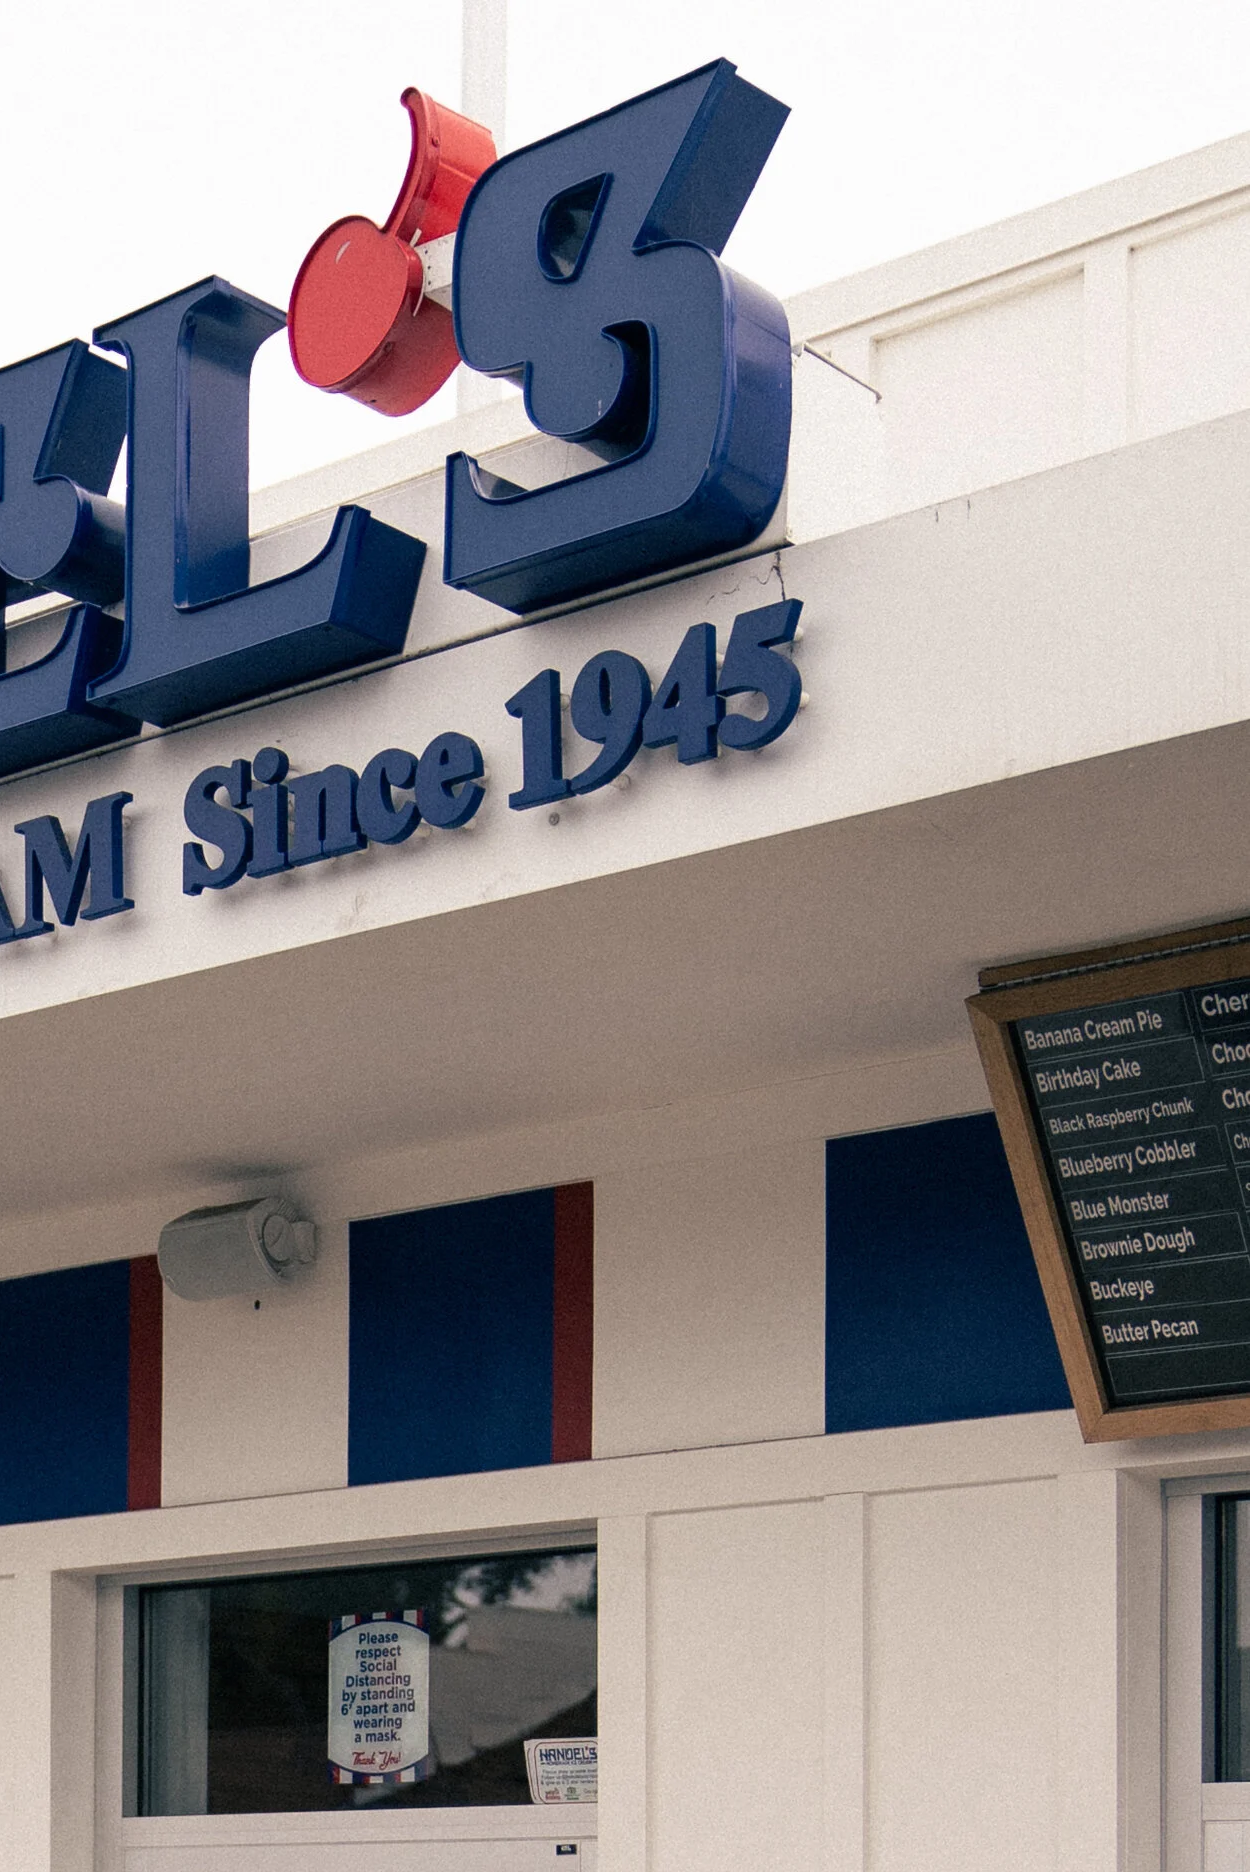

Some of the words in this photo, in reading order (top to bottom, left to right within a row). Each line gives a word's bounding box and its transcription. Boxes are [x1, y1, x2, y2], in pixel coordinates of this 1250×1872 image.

[182, 731, 485, 895] Since
[505, 597, 803, 811] 1945
[1201, 993, 1250, 1016] Cher
[1024, 1030, 1083, 1050] Banana
[1085, 1017, 1135, 1039] Cream
[1136, 1010, 1163, 1031] Pie
[1036, 1067, 1100, 1093] Birthday
[1102, 1059, 1141, 1081] Cake
[1049, 1115, 1086, 1135] Black
[1086, 1107, 1150, 1129] Raspberry
[1151, 1097, 1194, 1118] Chunk
[1059, 1152, 1133, 1178] Blueberry
[1135, 1140, 1196, 1165] Cobbler
[1071, 1200, 1106, 1220] Blue
[1107, 1192, 1169, 1216] Monster
[1081, 1235, 1142, 1260] Brownie
[1144, 1227, 1195, 1253] Dough
[1090, 1278, 1154, 1301] Buckeye
[1102, 1325, 1149, 1344] Butter
[1151, 1320, 1199, 1338] Pecan
[359, 1632, 398, 1644] Please
[356, 1646, 401, 1660] respect
[360, 1660, 397, 1672] Social
[346, 1674, 411, 1687] Distancing
[342, 1690, 357, 1705] by
[360, 1688, 414, 1701] standing
[356, 1703, 389, 1717] apart
[392, 1701, 415, 1712] and
[354, 1717, 402, 1729] wearing
[354, 1733, 361, 1743] a
[365, 1730, 401, 1742] mask.
[352, 1752, 376, 1766] Thank
